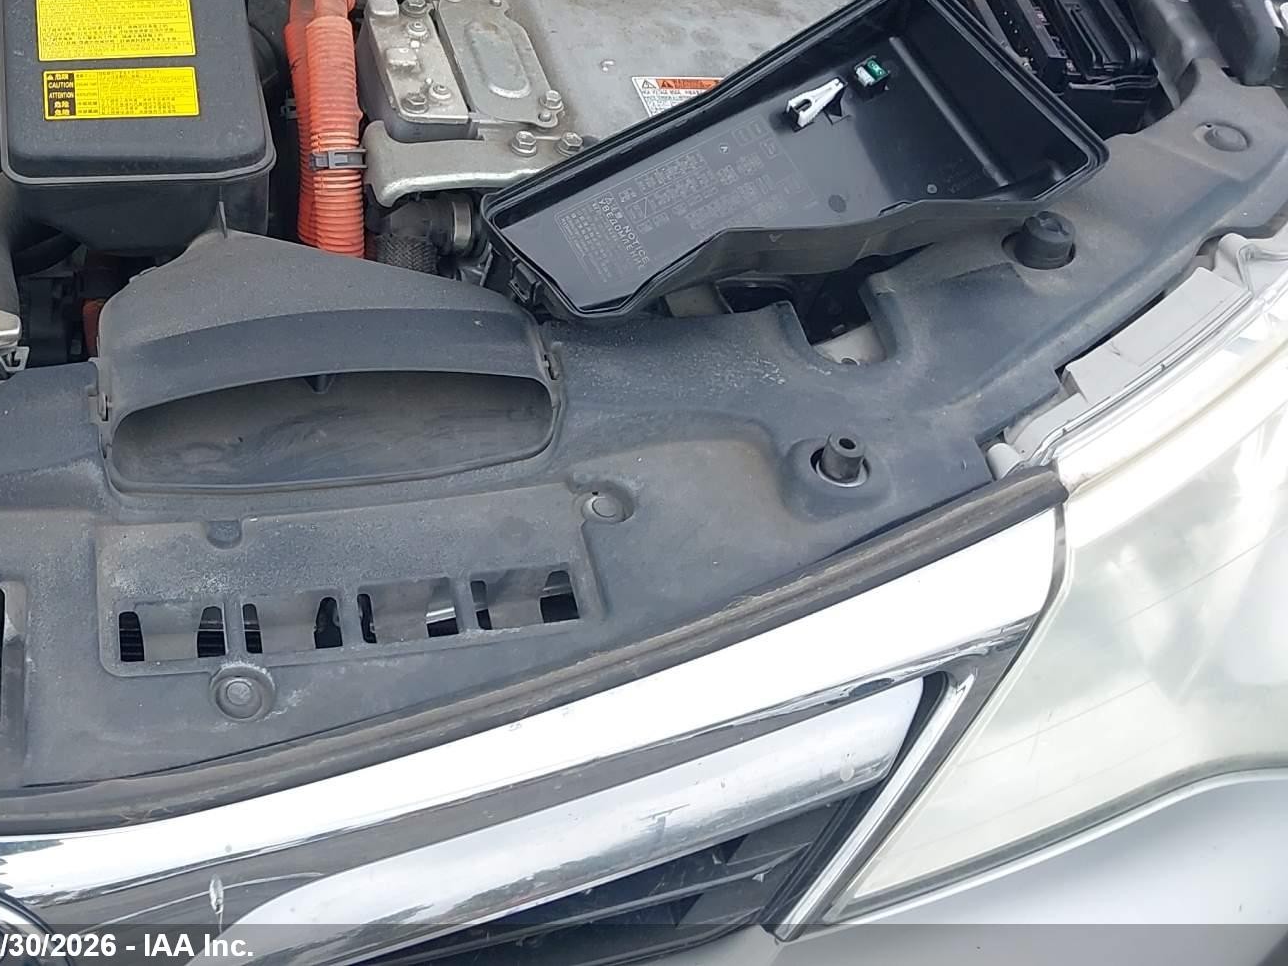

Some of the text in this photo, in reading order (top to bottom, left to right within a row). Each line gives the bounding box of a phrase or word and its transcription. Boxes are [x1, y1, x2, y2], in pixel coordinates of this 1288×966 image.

[48, 81, 74, 89] CAUTION
[49, 91, 75, 99] ATTENTION
[622, 225, 649, 265] NOTICE
